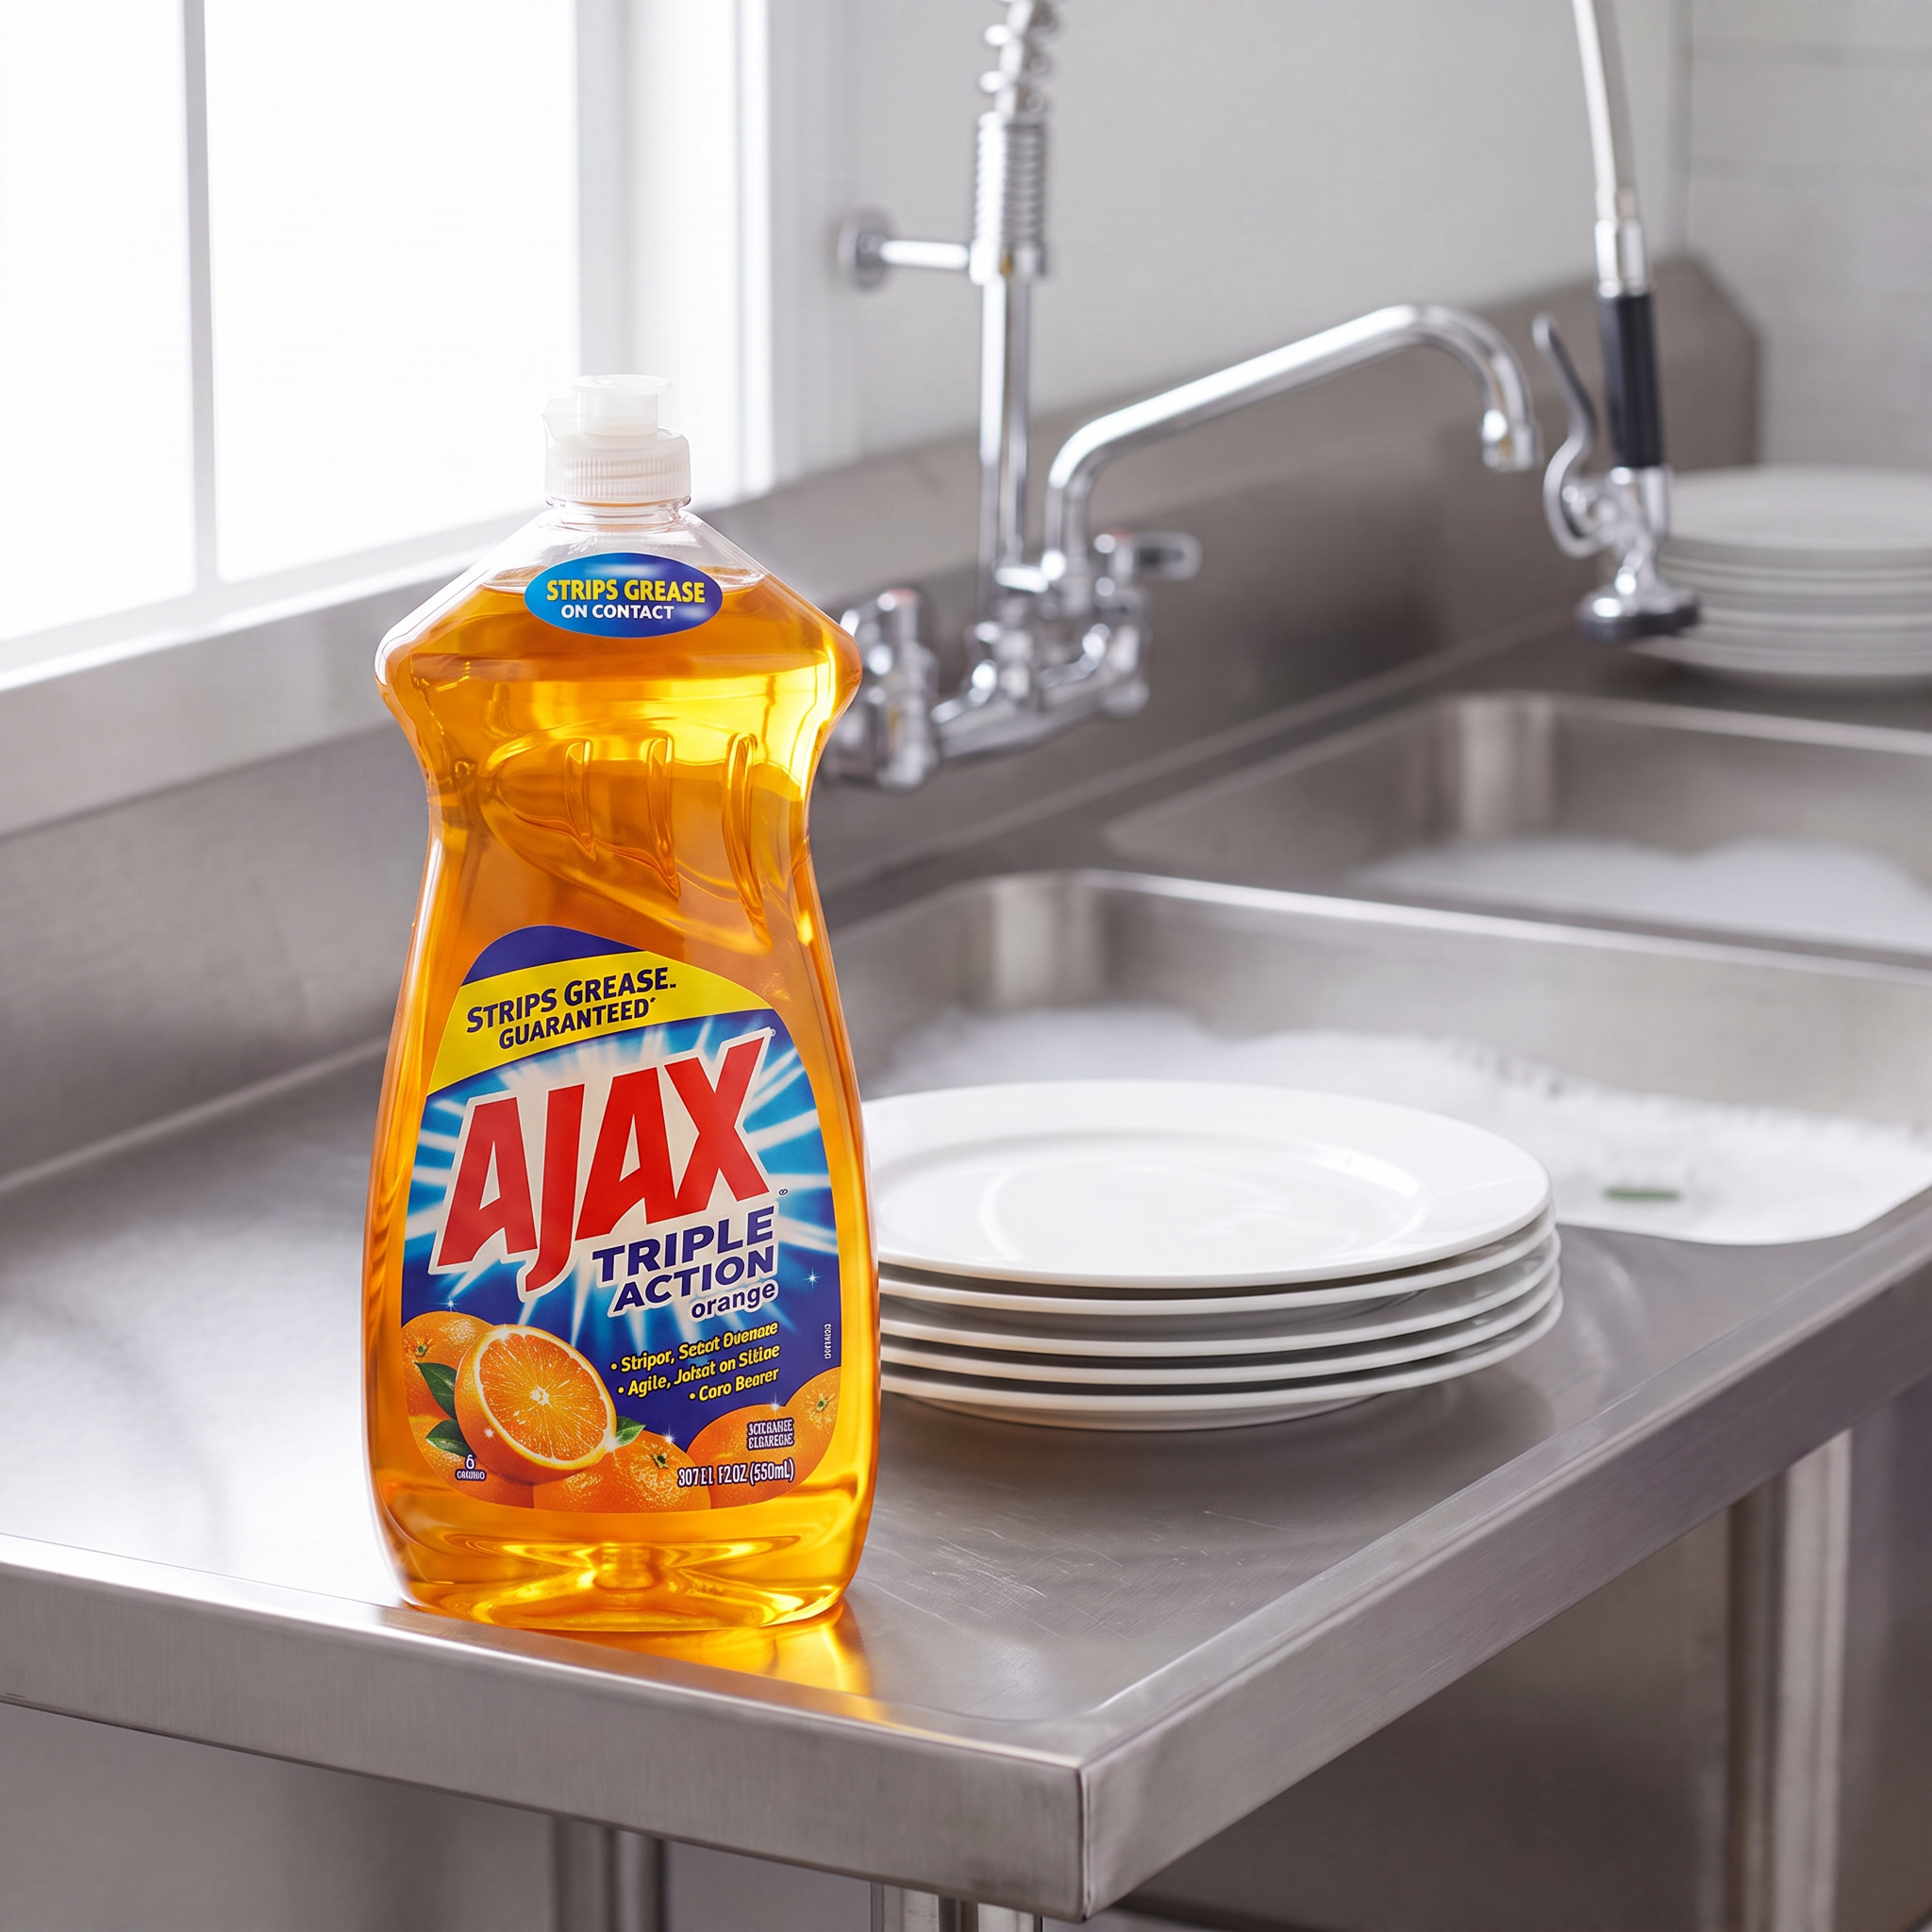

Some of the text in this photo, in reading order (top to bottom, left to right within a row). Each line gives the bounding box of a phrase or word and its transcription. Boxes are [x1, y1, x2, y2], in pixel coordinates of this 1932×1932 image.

[546, 579, 706, 603] STRIPS GREASE
[561, 605, 675, 620] ON CONTACT
[466, 988, 558, 1033] STRIPS
[436, 1036, 771, 1293] AJAX
[591, 1206, 775, 1283] TRIPLE
[613, 1244, 774, 1312] ACTION
[691, 1282, 775, 1320] orange
[620, 1350, 675, 1373] Stripor,
[627, 1374, 672, 1398] Agile,
[719, 1358, 736, 1373] on
[735, 1368, 779, 1391] Bearer
